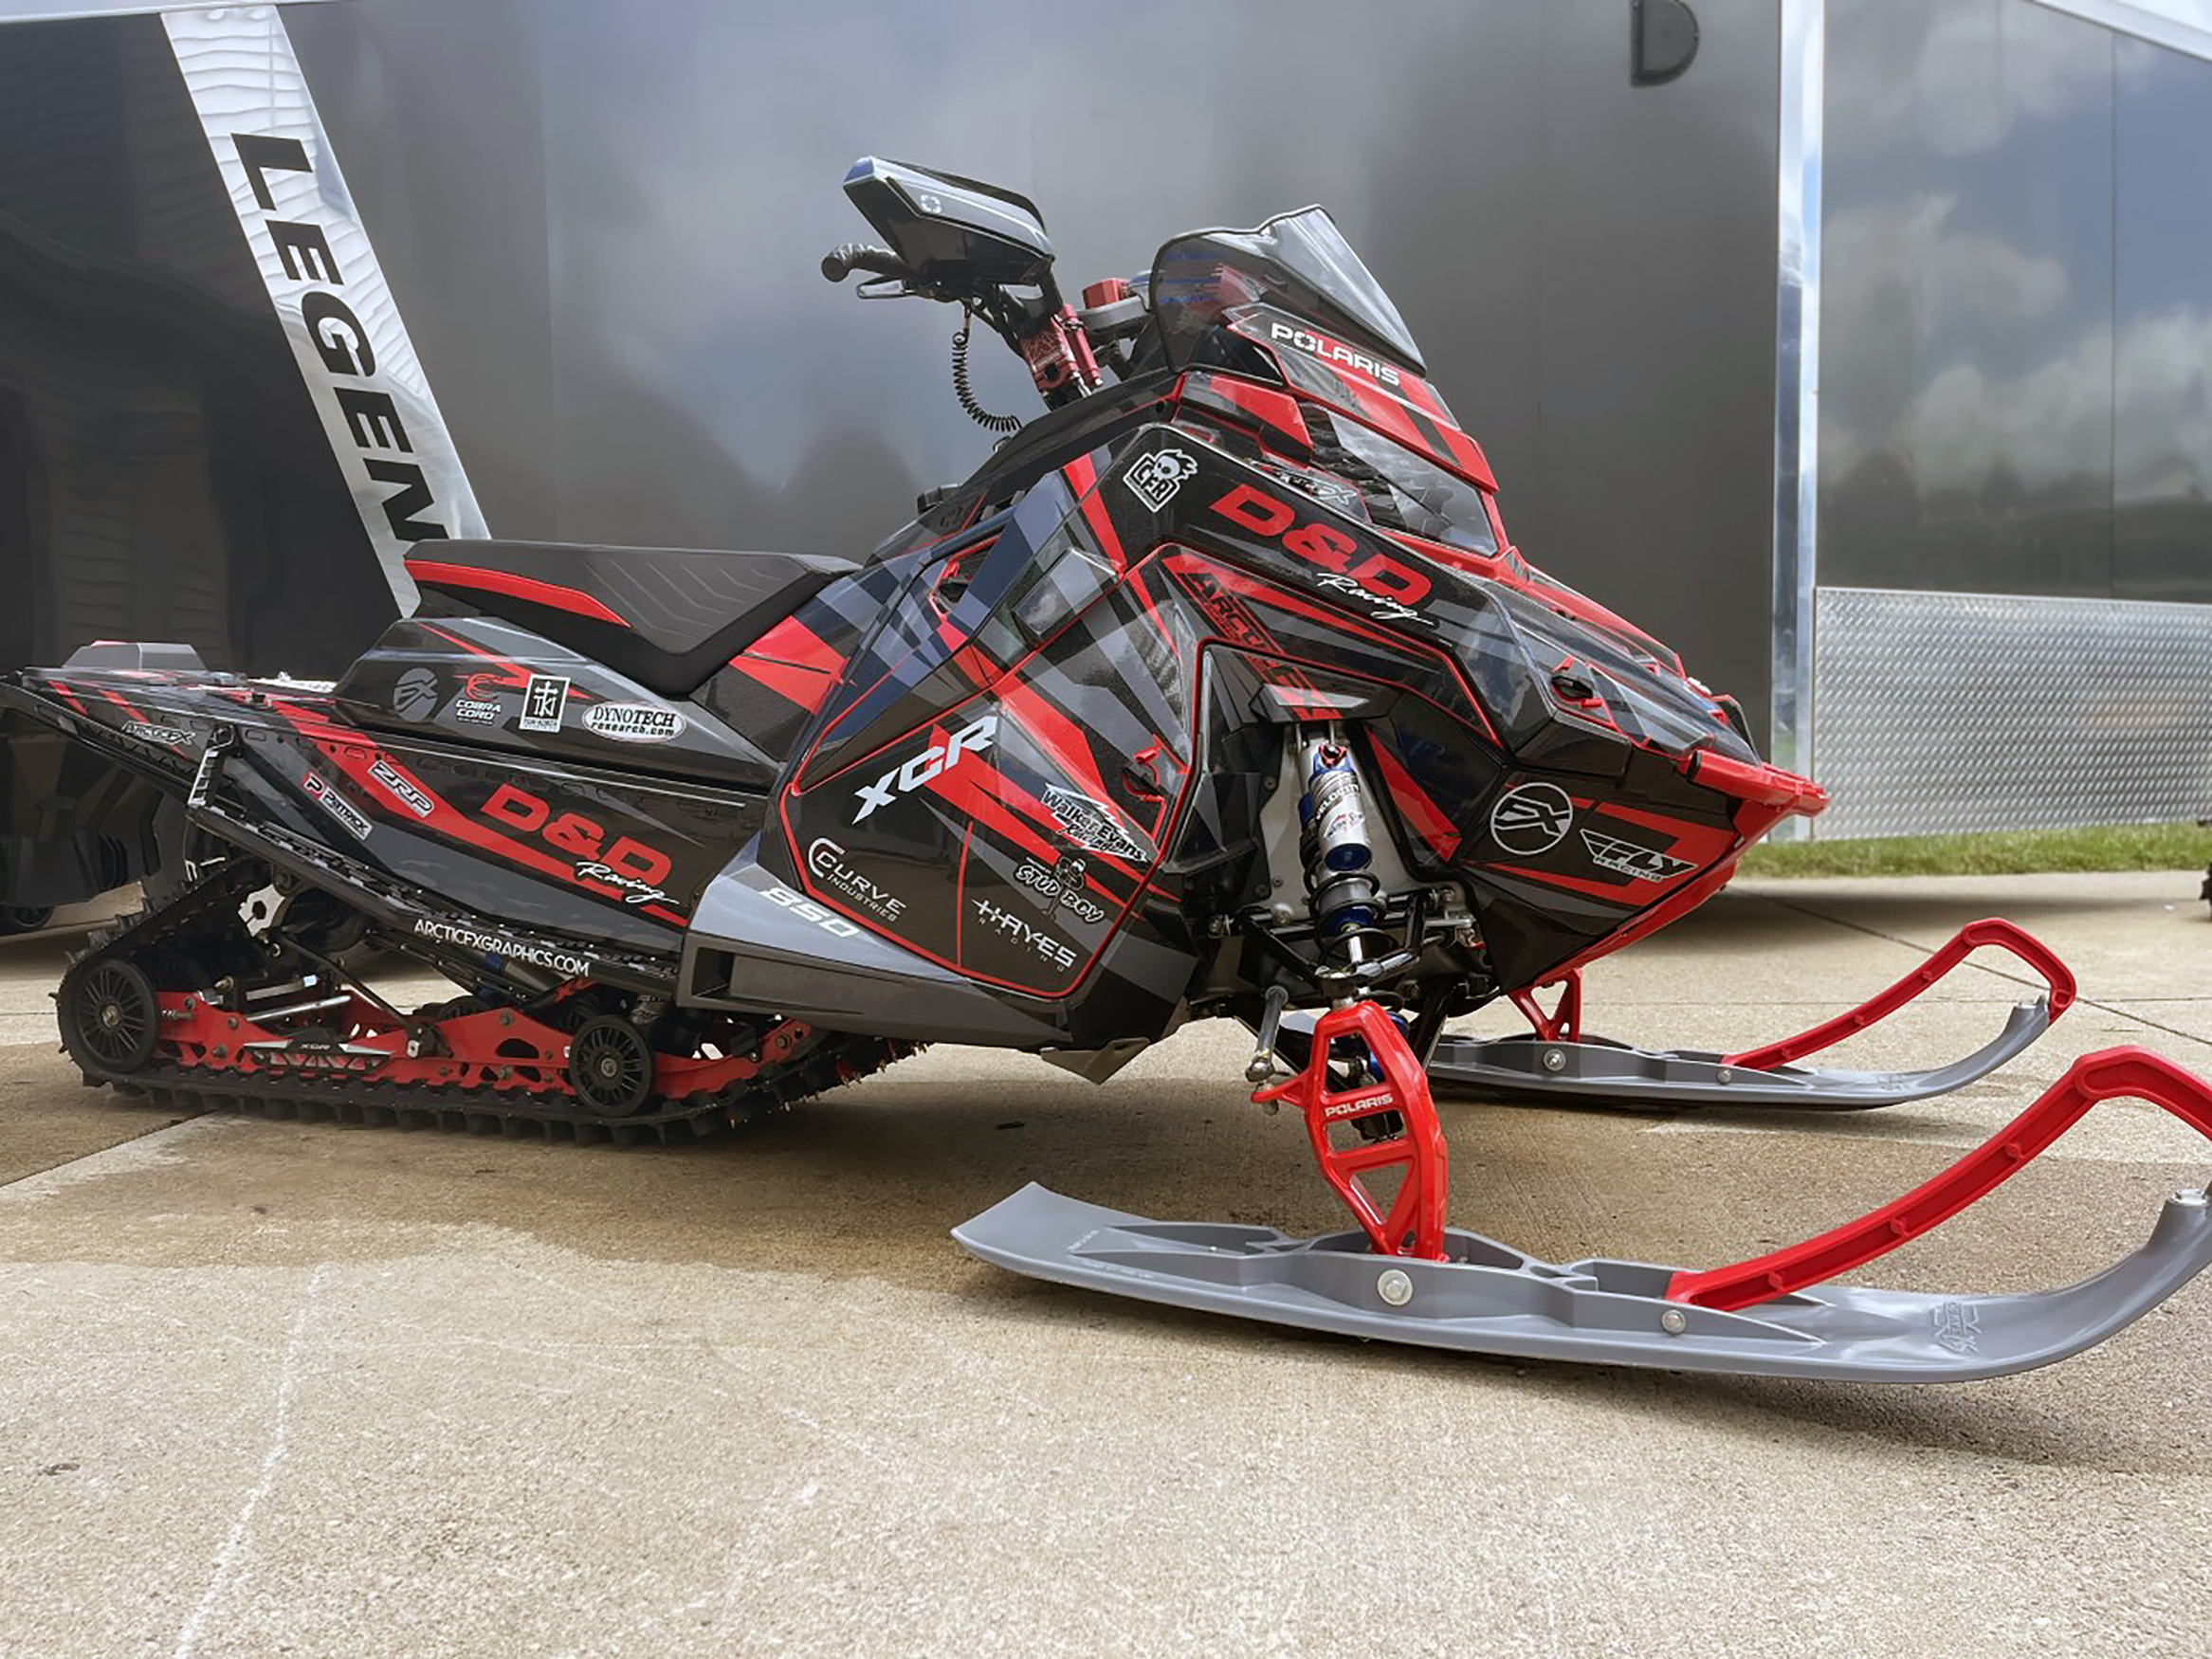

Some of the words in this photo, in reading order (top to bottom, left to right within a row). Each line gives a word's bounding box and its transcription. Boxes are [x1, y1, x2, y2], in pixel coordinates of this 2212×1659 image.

[1271, 322, 1400, 387] POLARIS
[1209, 483, 1432, 606] D&D
[1317, 572, 1435, 627] Racing
[456, 700, 502, 713] COBRA
[457, 708, 495, 720] CORD
[591, 721, 675, 736] research.com
[593, 706, 676, 727] DYNOTECH
[372, 761, 433, 812] ZRP
[851, 716, 997, 826] XCR
[480, 783, 671, 885] D&D
[1041, 789, 1102, 835] Walker
[1096, 823, 1143, 861] Evans
[576, 861, 680, 903] Racing
[809, 838, 906, 917] CURVE
[827, 874, 898, 922] INDUSTRIES
[1015, 864, 1061, 897] STUD
[1060, 889, 1106, 922] BOY
[759, 887, 860, 938] 850
[972, 900, 1077, 969] HAYES
[414, 919, 590, 977] ARCTICFXGRAPHICS.COM
[1325, 1093, 1394, 1117] POLARIS
